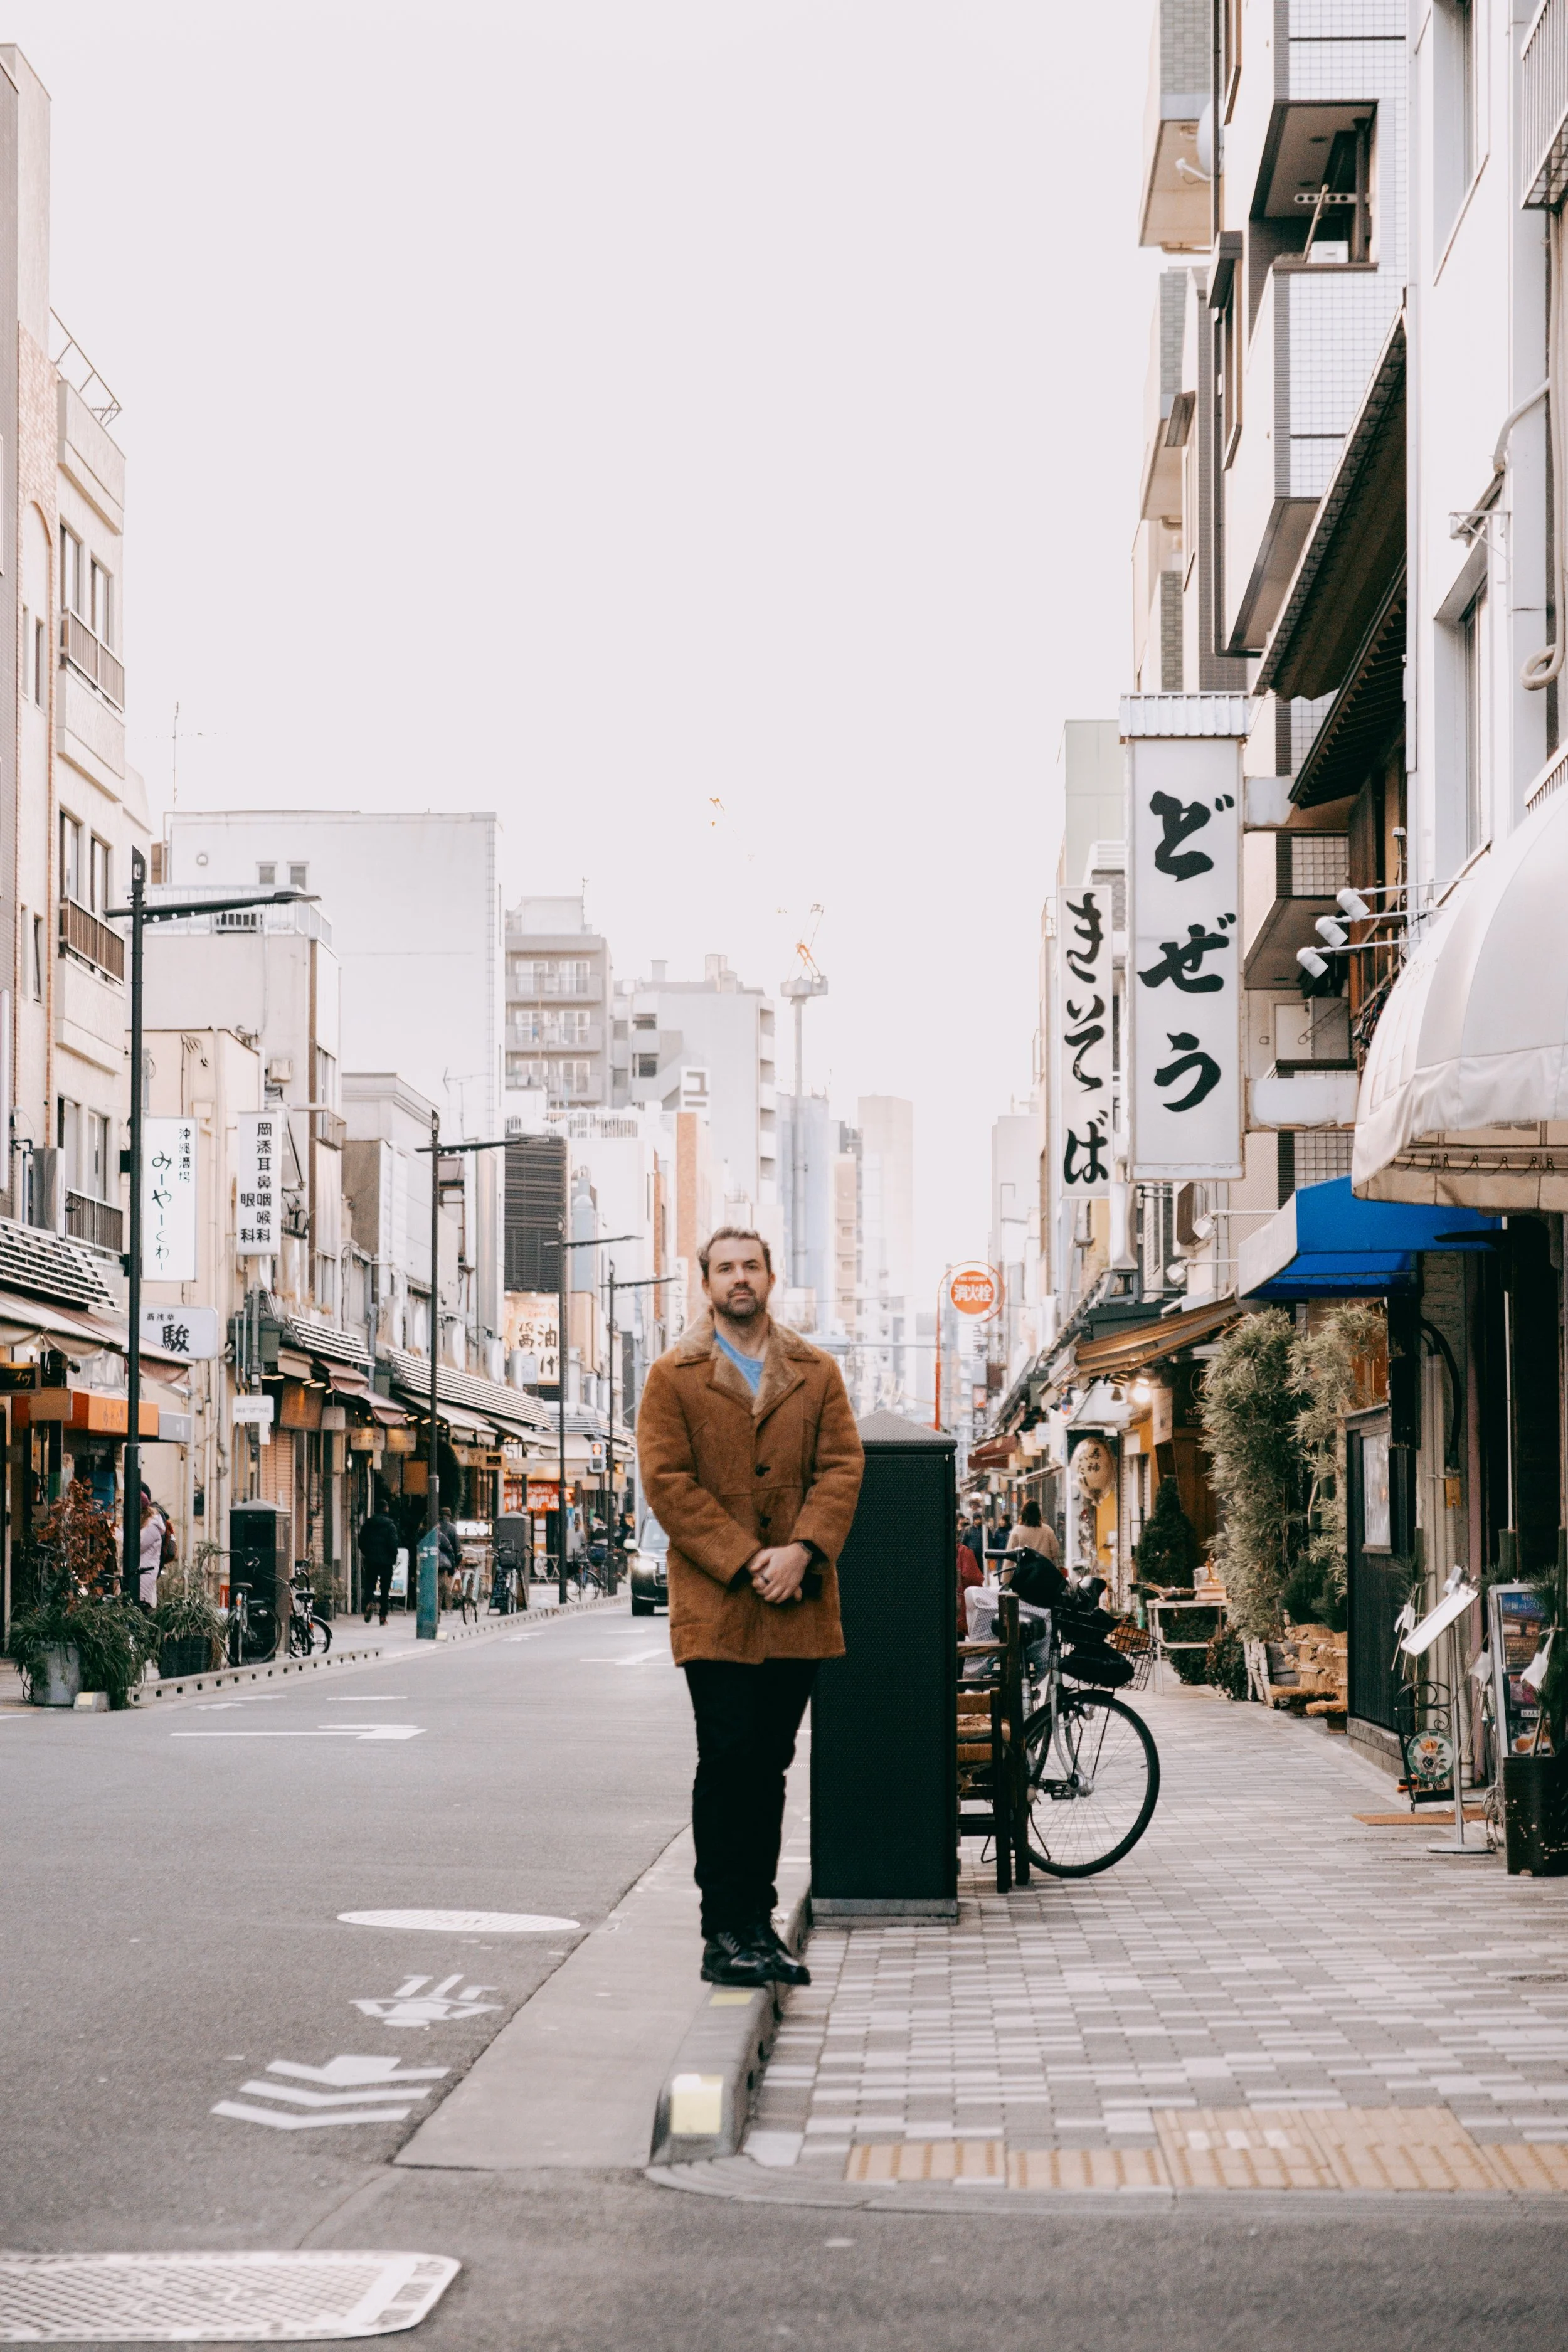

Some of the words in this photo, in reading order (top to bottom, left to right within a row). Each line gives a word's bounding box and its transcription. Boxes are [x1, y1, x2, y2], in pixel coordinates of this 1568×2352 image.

[1136, 790, 1236, 1113] どぜう
[1064, 893, 1109, 1185] きそば
[240, 1193, 255, 1243] 眼科
[257, 1123, 272, 1243] 岡添耳鼻咽喉科
[953, 1284, 992, 1301] 消火栓
[161, 1324, 190, 1352] 駿
